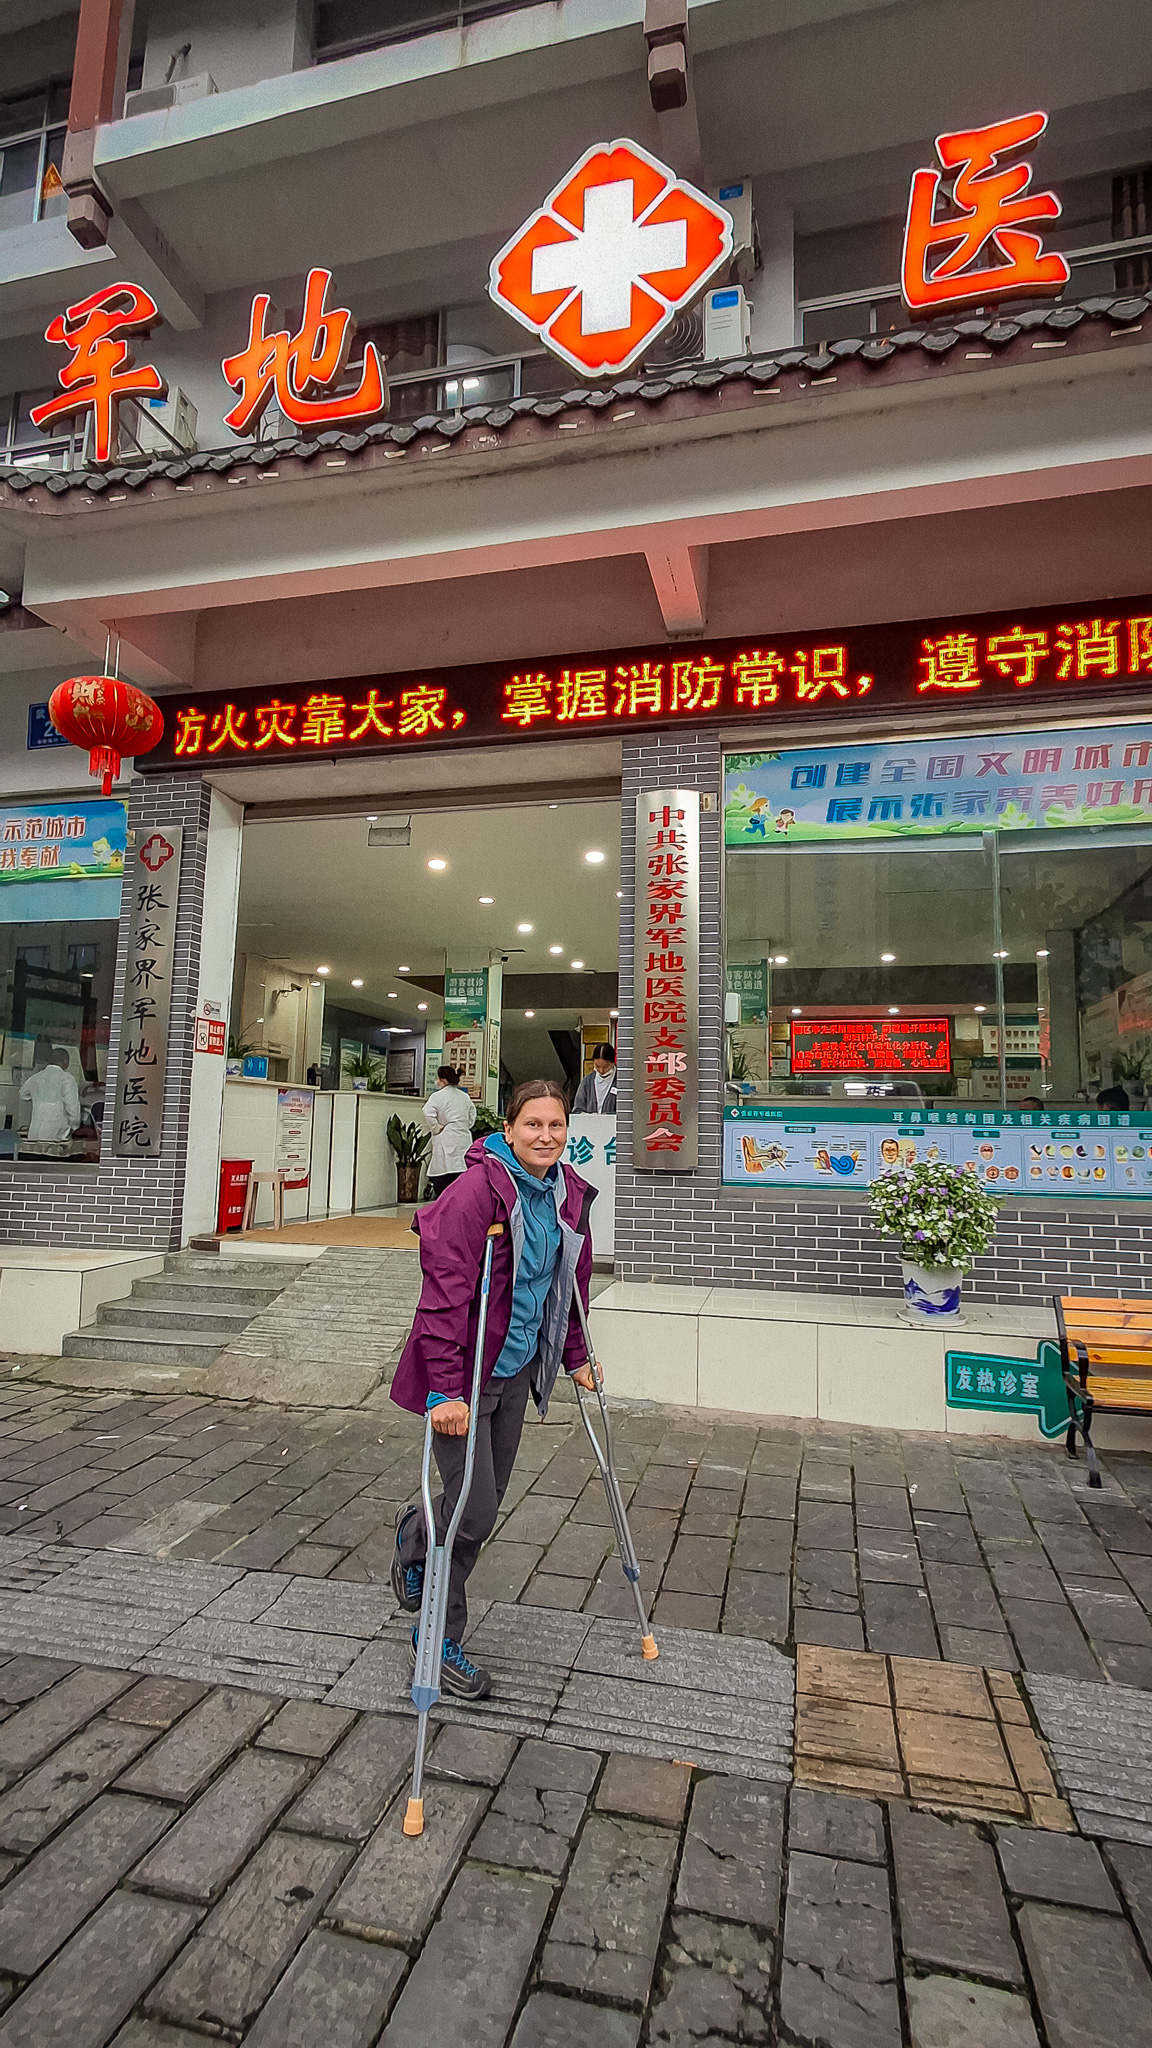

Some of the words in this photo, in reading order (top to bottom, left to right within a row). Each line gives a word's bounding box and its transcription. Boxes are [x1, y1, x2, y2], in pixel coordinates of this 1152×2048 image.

[902, 110, 1072, 310] 医
[790, 740, 1152, 790] 创建全国文明城市
[0, 815, 87, 841] 示范城市
[118, 884, 170, 1147] 张家界军地医院
[643, 805, 688, 1152] 中共张家界军地医院支部委员会
[955, 1365, 1040, 1399] 发热诊室
